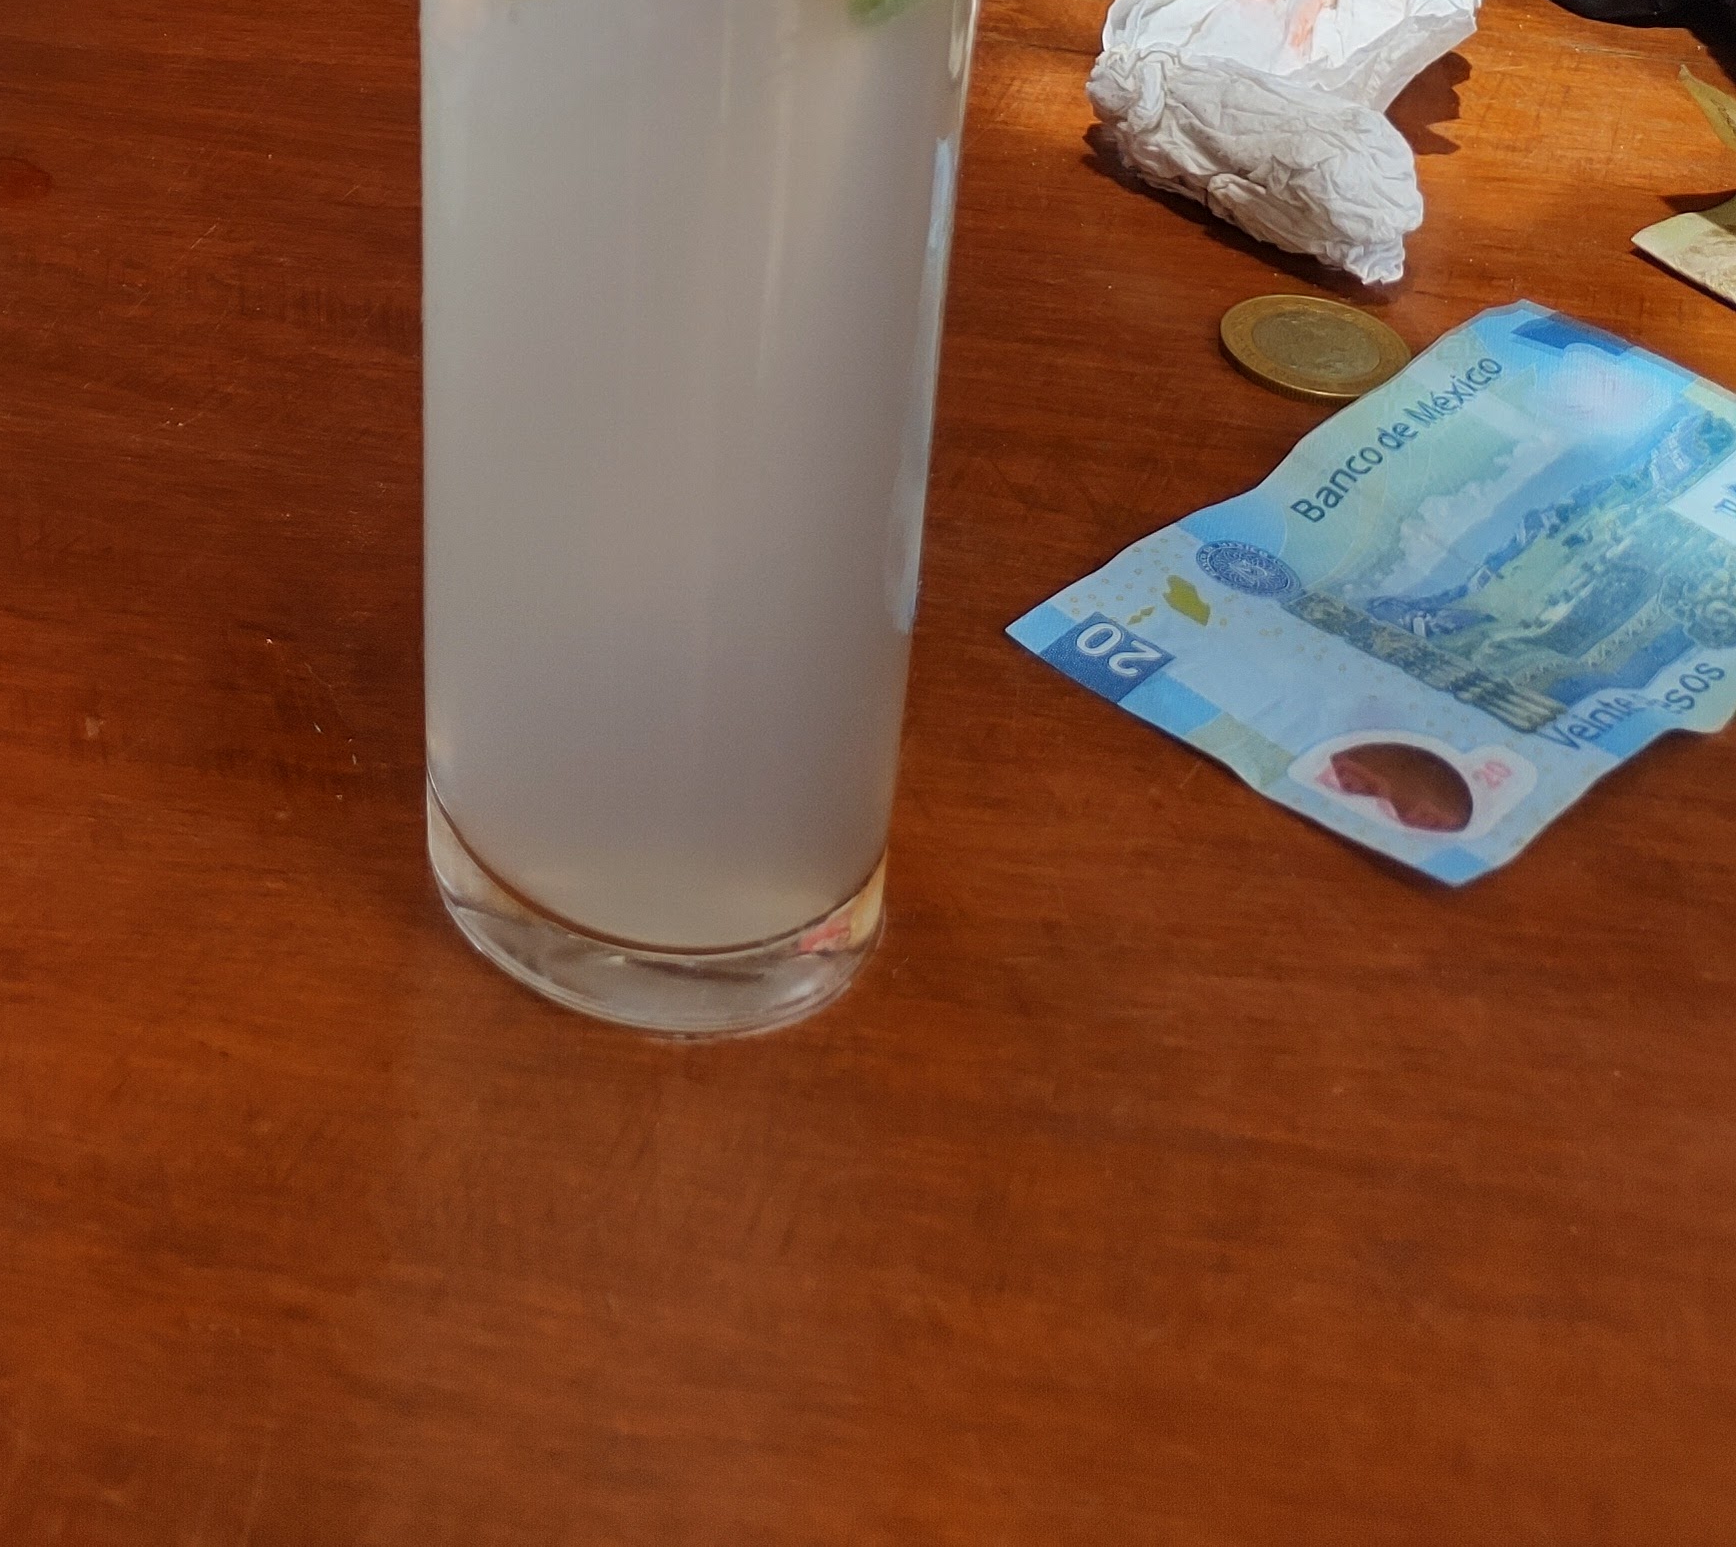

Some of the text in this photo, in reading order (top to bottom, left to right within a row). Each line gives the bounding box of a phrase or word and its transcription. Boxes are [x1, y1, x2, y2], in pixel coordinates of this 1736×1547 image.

[1290, 357, 1503, 523] Banco de México
[1075, 621, 1163, 677] 20
[1536, 695, 1641, 750] Veinte
